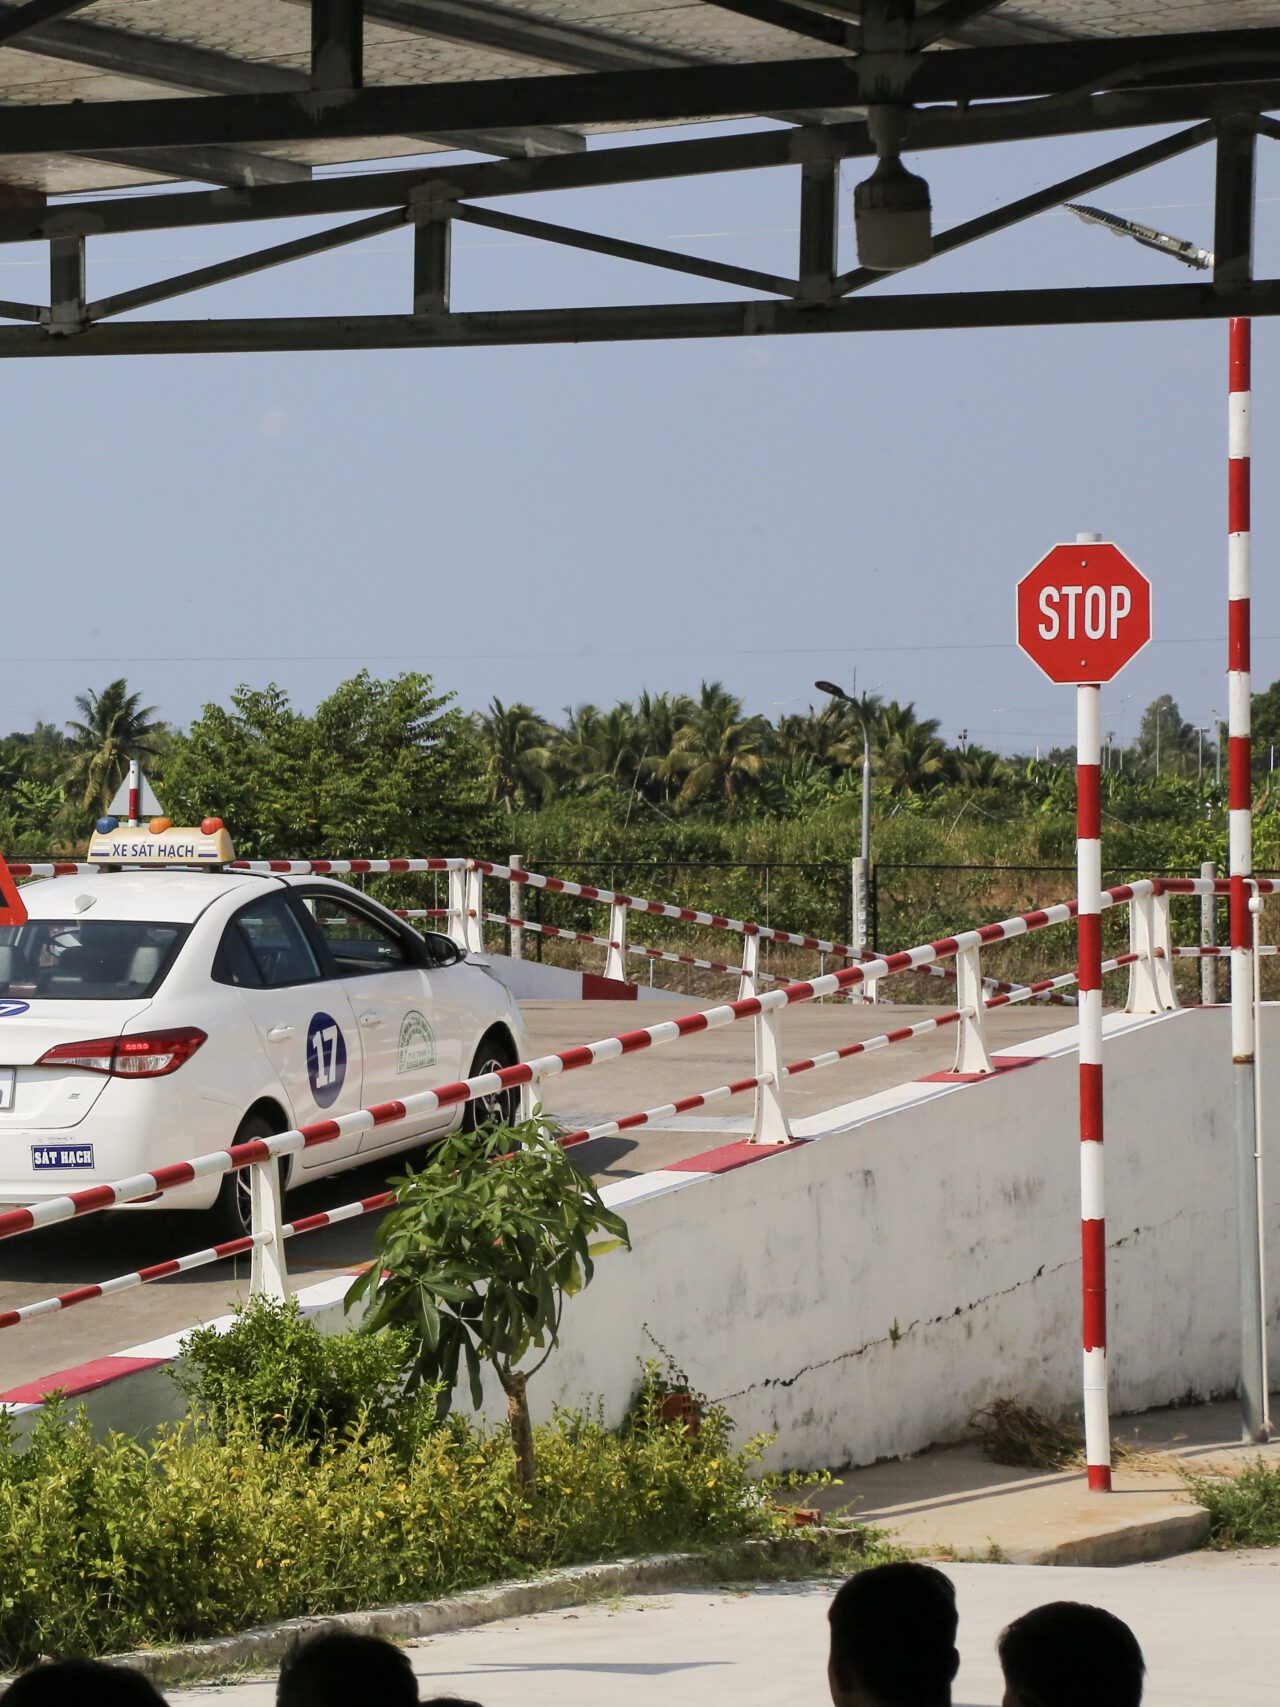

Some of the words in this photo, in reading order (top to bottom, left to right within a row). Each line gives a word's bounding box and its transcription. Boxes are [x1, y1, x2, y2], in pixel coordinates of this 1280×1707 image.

[1037, 585, 1132, 641] STOP
[112, 843, 128, 857] XE
[131, 841, 154, 857] SÁT
[157, 844, 194, 859] HẠCH
[312, 1024, 338, 1089] 17
[34, 1147, 58, 1165] SÁT
[60, 1150, 92, 1167] HẠCH
